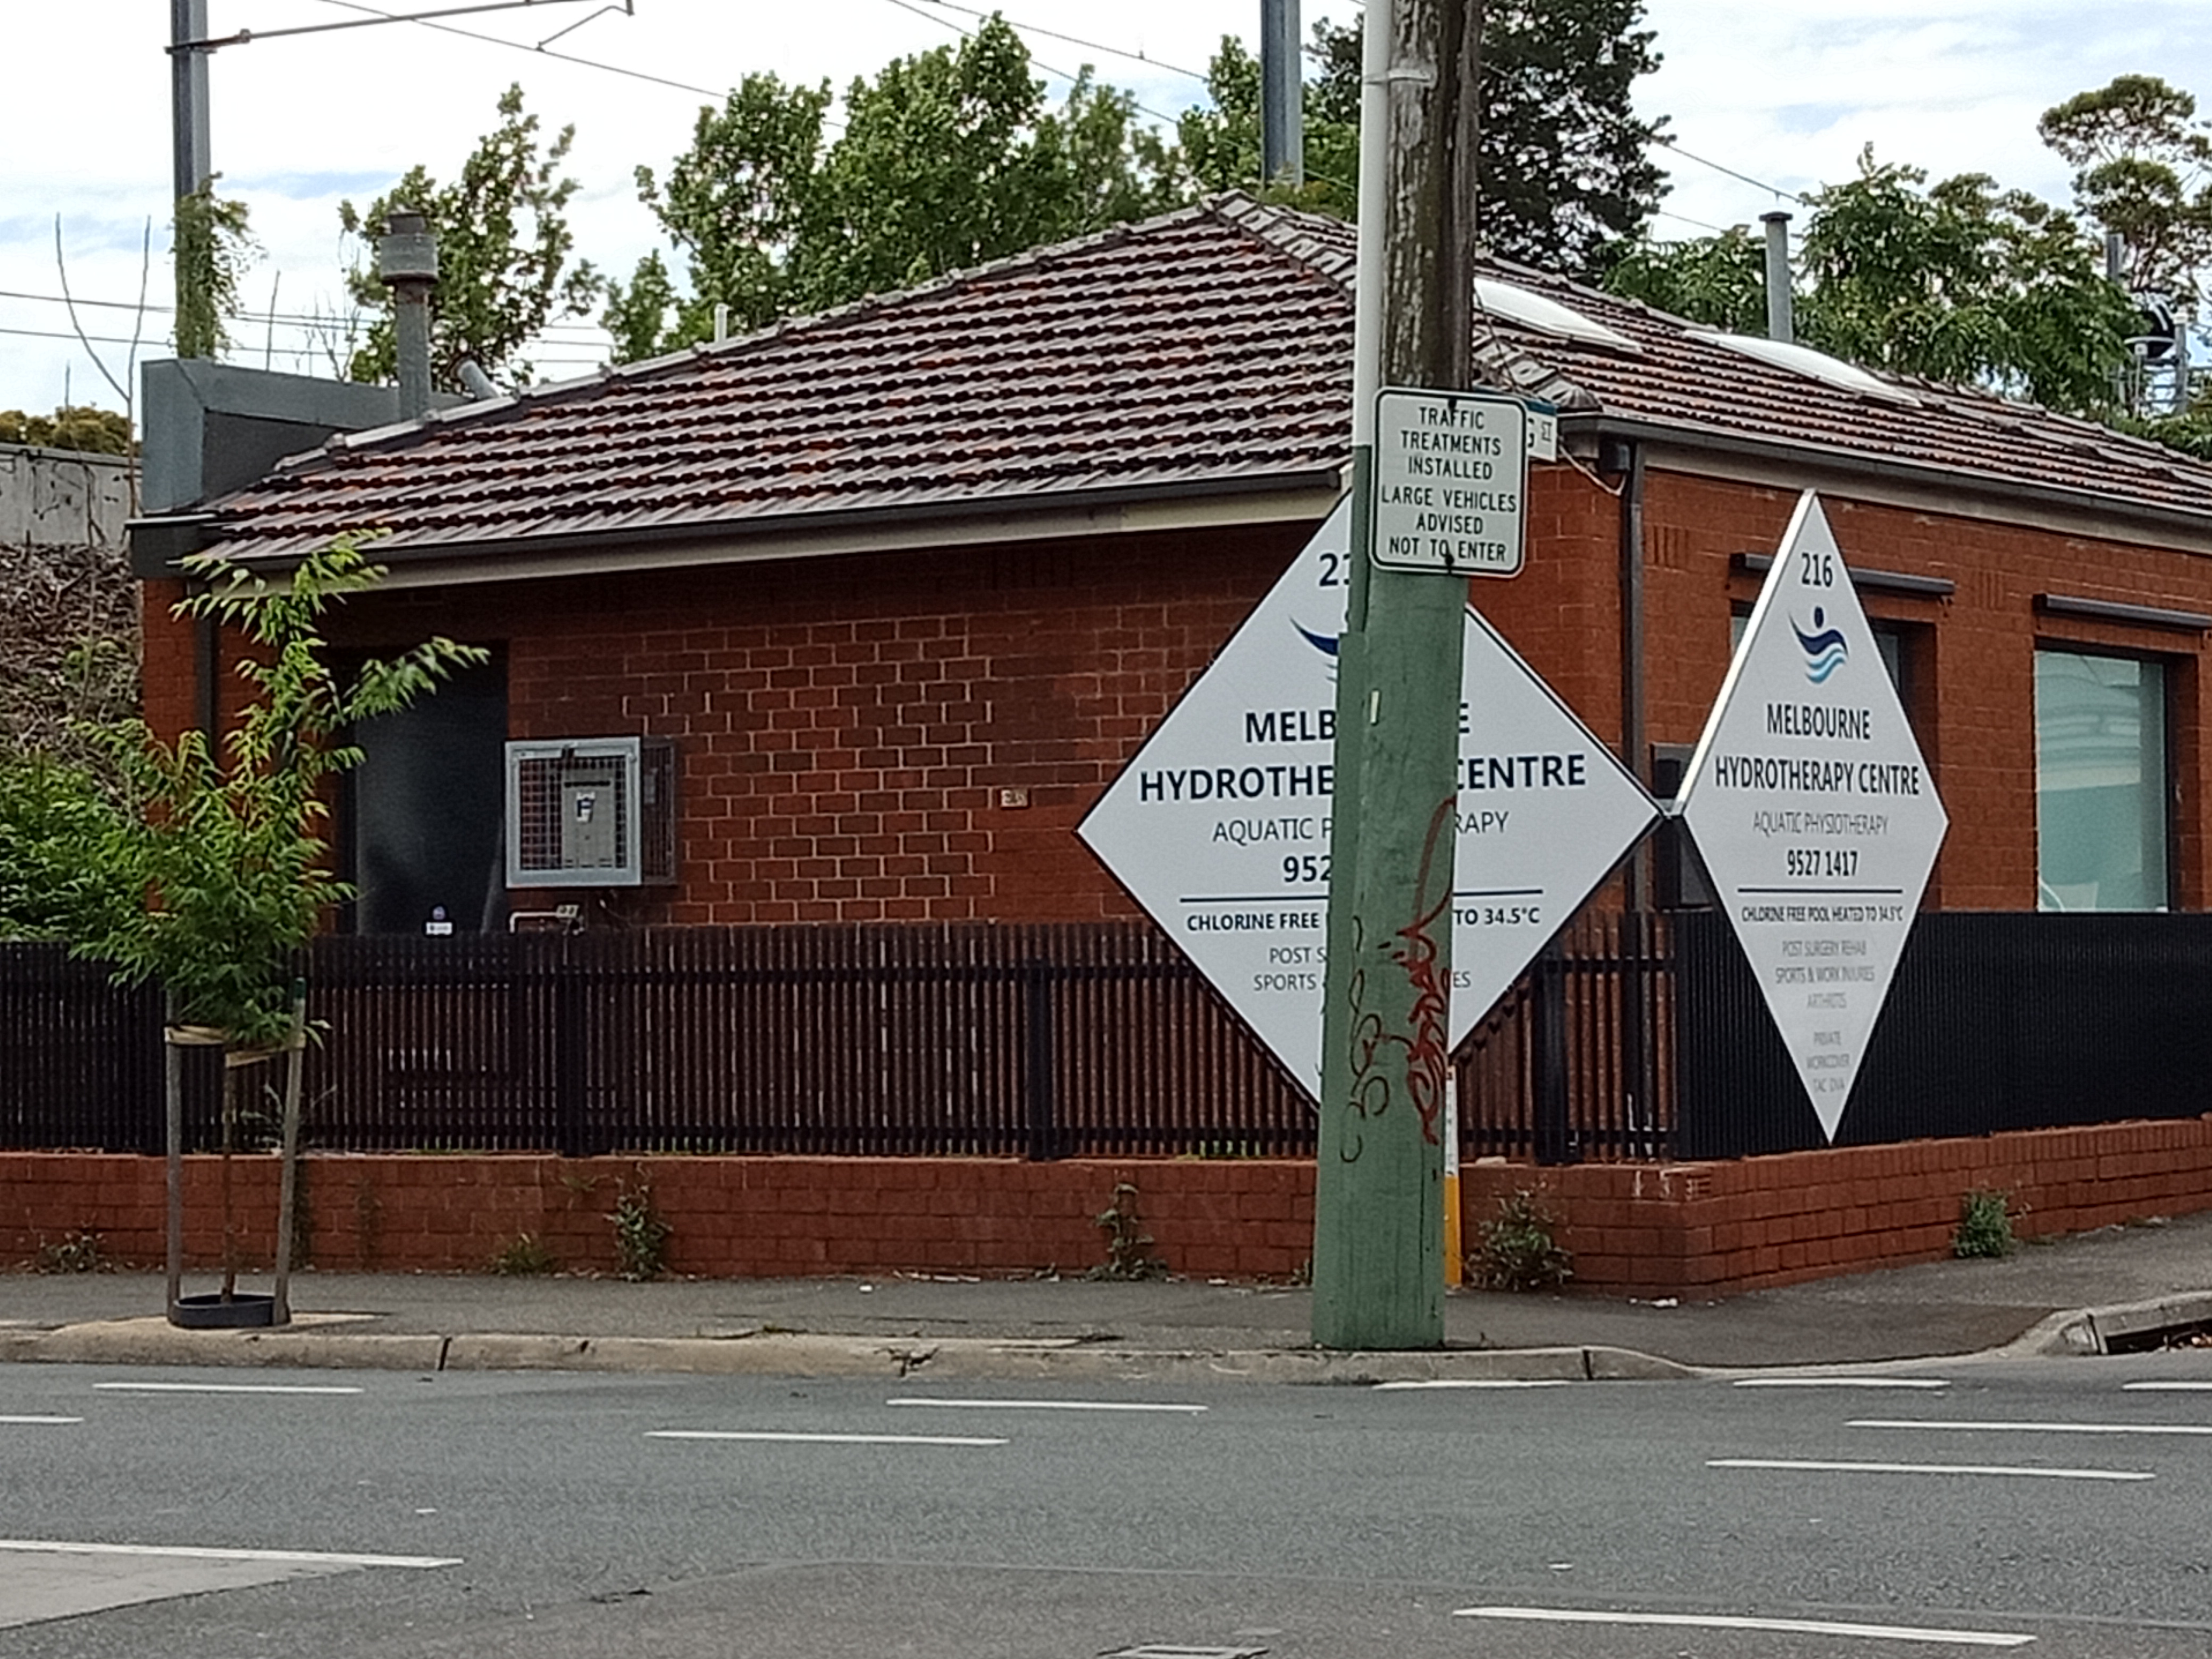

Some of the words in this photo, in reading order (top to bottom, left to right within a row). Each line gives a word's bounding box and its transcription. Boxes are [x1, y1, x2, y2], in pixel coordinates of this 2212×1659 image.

[1419, 407, 1485, 429] TRAFFIC
[1401, 430, 1501, 456] TREATMENTS
[1409, 456, 1492, 480] INSTALLED
[1381, 485, 1433, 506] LARGE
[1443, 490, 1516, 513] VEHICLES
[1416, 513, 1483, 534] ADVISED
[1389, 537, 1420, 556] NOT
[1430, 539, 1449, 558] TO
[1459, 541, 1505, 562] ENTER
[1802, 552, 1833, 587] 216
[1767, 703, 1870, 740] MELBOURNE
[1715, 756, 1853, 792] HYDROTHERAPY
[1859, 763, 1919, 795] CENTRE
[1212, 818, 1313, 847] AQUATIC
[1754, 811, 1801, 837] AQUATIC
[1805, 813, 1889, 835] PHYSIOTHERAPY
[1283, 855, 1334, 883] 952
[1787, 850, 1821, 876] 9527
[1825, 851, 1858, 876] 1417
[1187, 913, 1275, 931] CHLORINE
[1280, 912, 1320, 929] FREE
[1453, 909, 1478, 925] TO
[1808, 906, 1830, 922] POOL
[1270, 947, 1312, 963] POST
[1254, 974, 1317, 991] SPORTS
